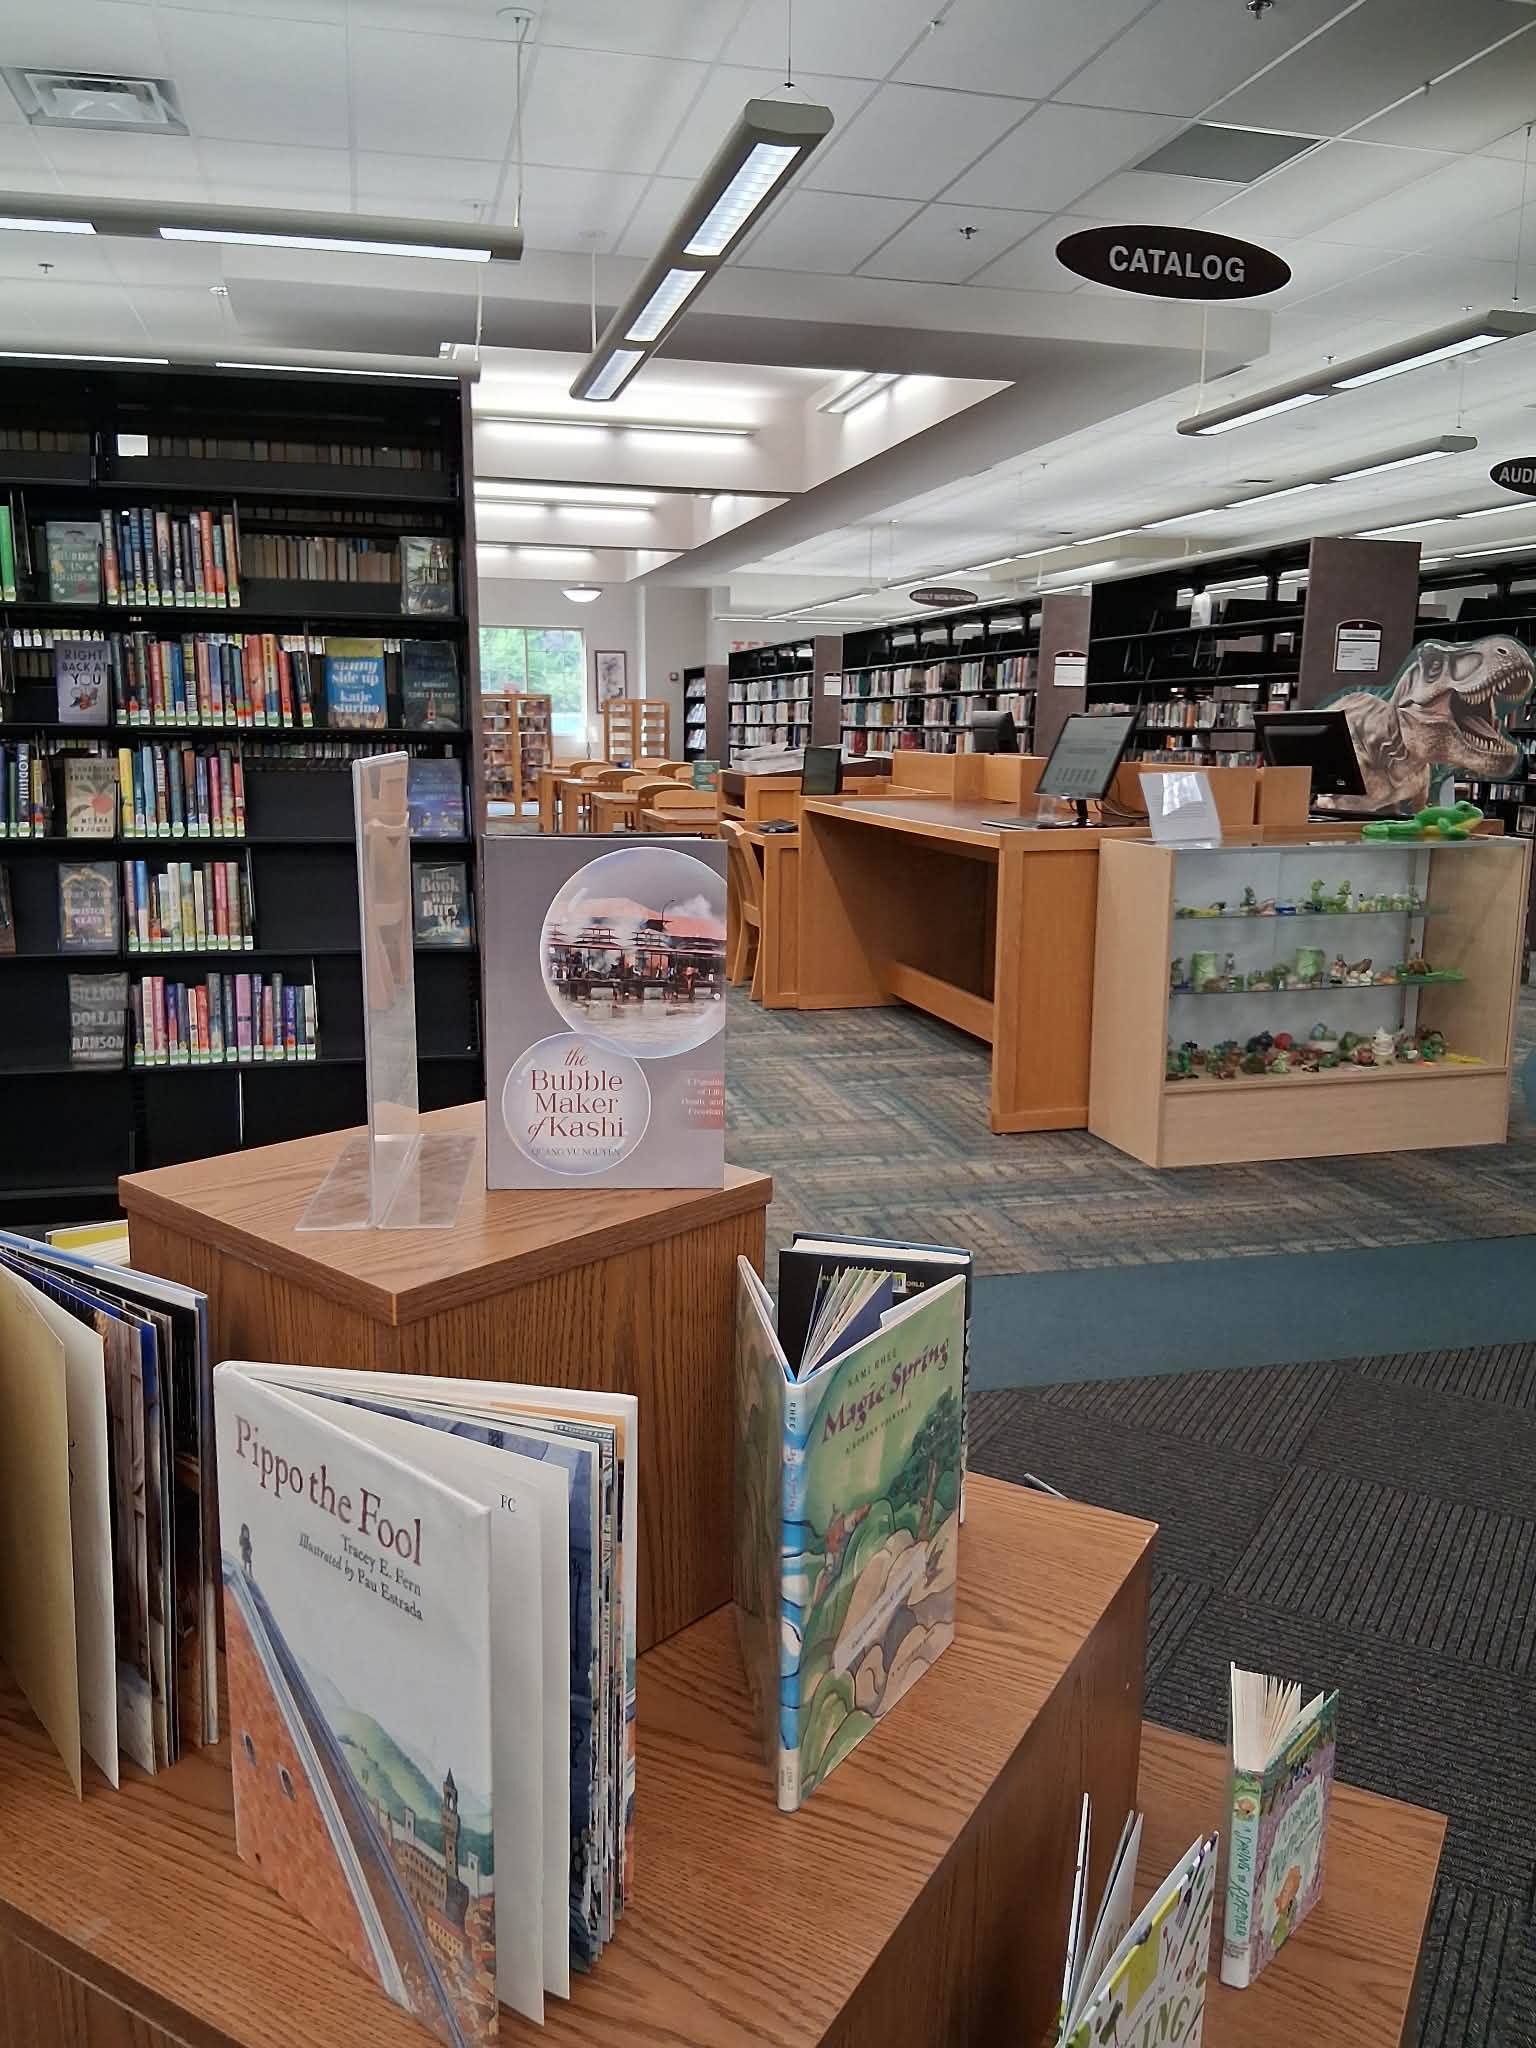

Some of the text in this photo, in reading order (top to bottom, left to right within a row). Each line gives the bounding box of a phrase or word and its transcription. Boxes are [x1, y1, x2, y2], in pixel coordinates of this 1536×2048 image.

[1108, 245, 1246, 283] CATALOG
[64, 649, 104, 660] RIGHT
[63, 663, 89, 672] BACK
[332, 671, 379, 687] side up
[71, 673, 102, 686] YOU
[564, 1047, 588, 1067] the
[531, 1069, 623, 1092] Bubble
[536, 1092, 619, 1114] Maker
[528, 1116, 625, 1145] of Kashi
[822, 1382, 888, 1444] Magic
[889, 1337, 949, 1400] Spring
[235, 1414, 422, 1567] Pippo the Fool
[299, 1532, 423, 1621] Illustrated by Pau Estrada
[341, 1534, 422, 1597] Tracey E. Fern
